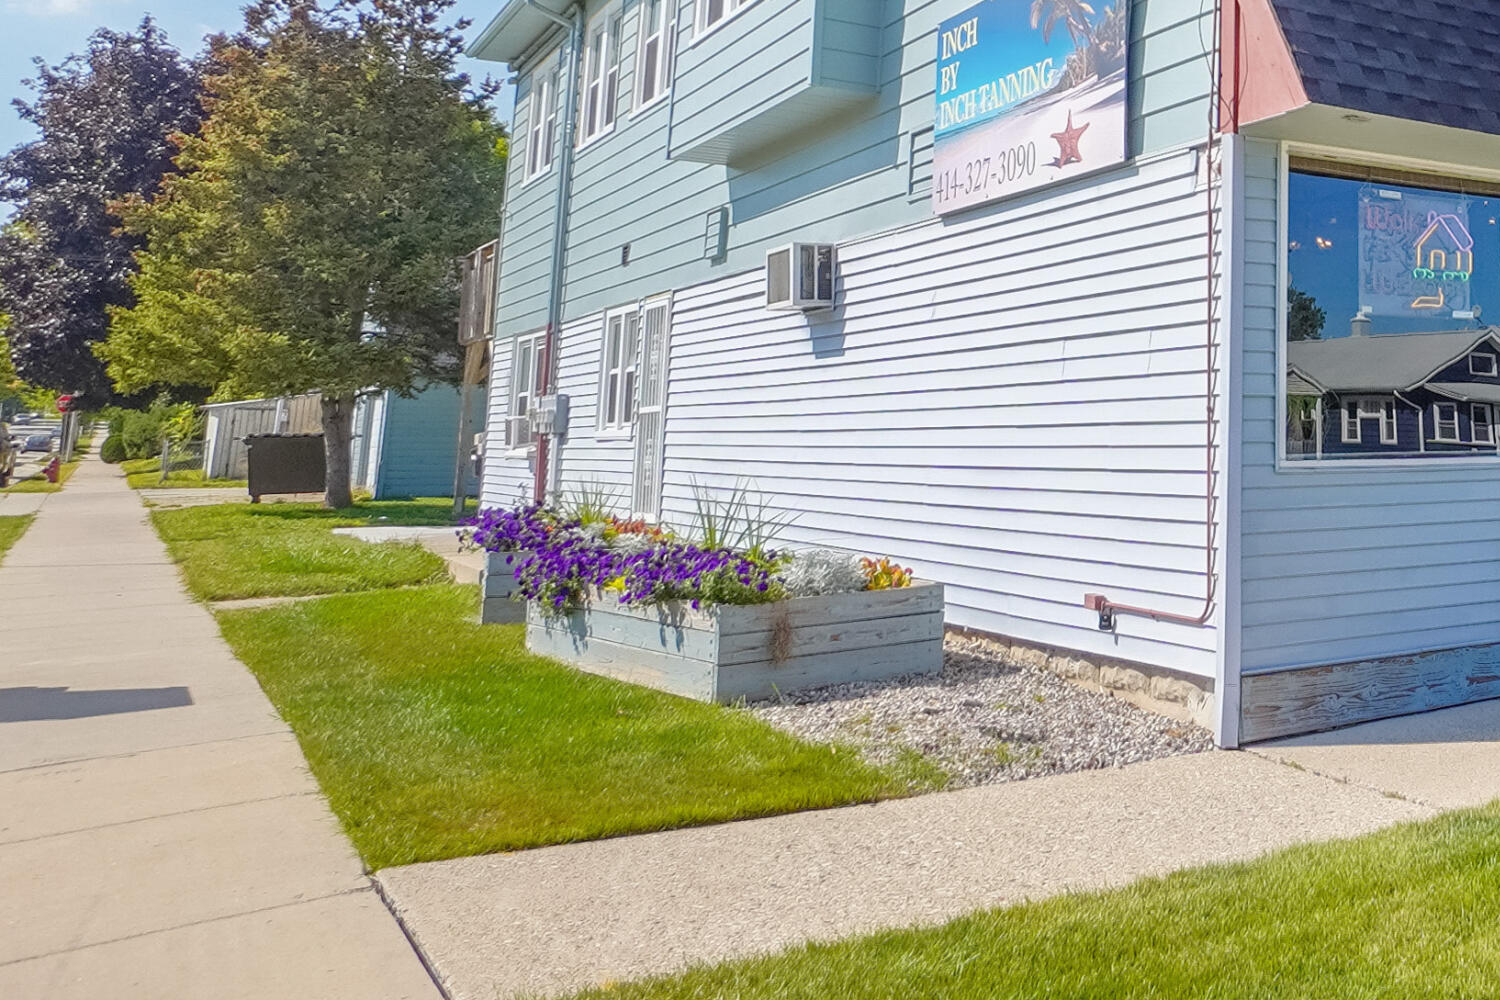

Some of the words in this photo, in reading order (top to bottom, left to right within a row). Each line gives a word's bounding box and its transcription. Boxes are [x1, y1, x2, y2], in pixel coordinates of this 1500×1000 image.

[941, 16, 979, 61] INCH
[938, 89, 977, 129] INCH
[978, 57, 1053, 114] TANNING
[940, 61, 960, 96] BY
[935, 141, 1036, 203] 414-327-3090
